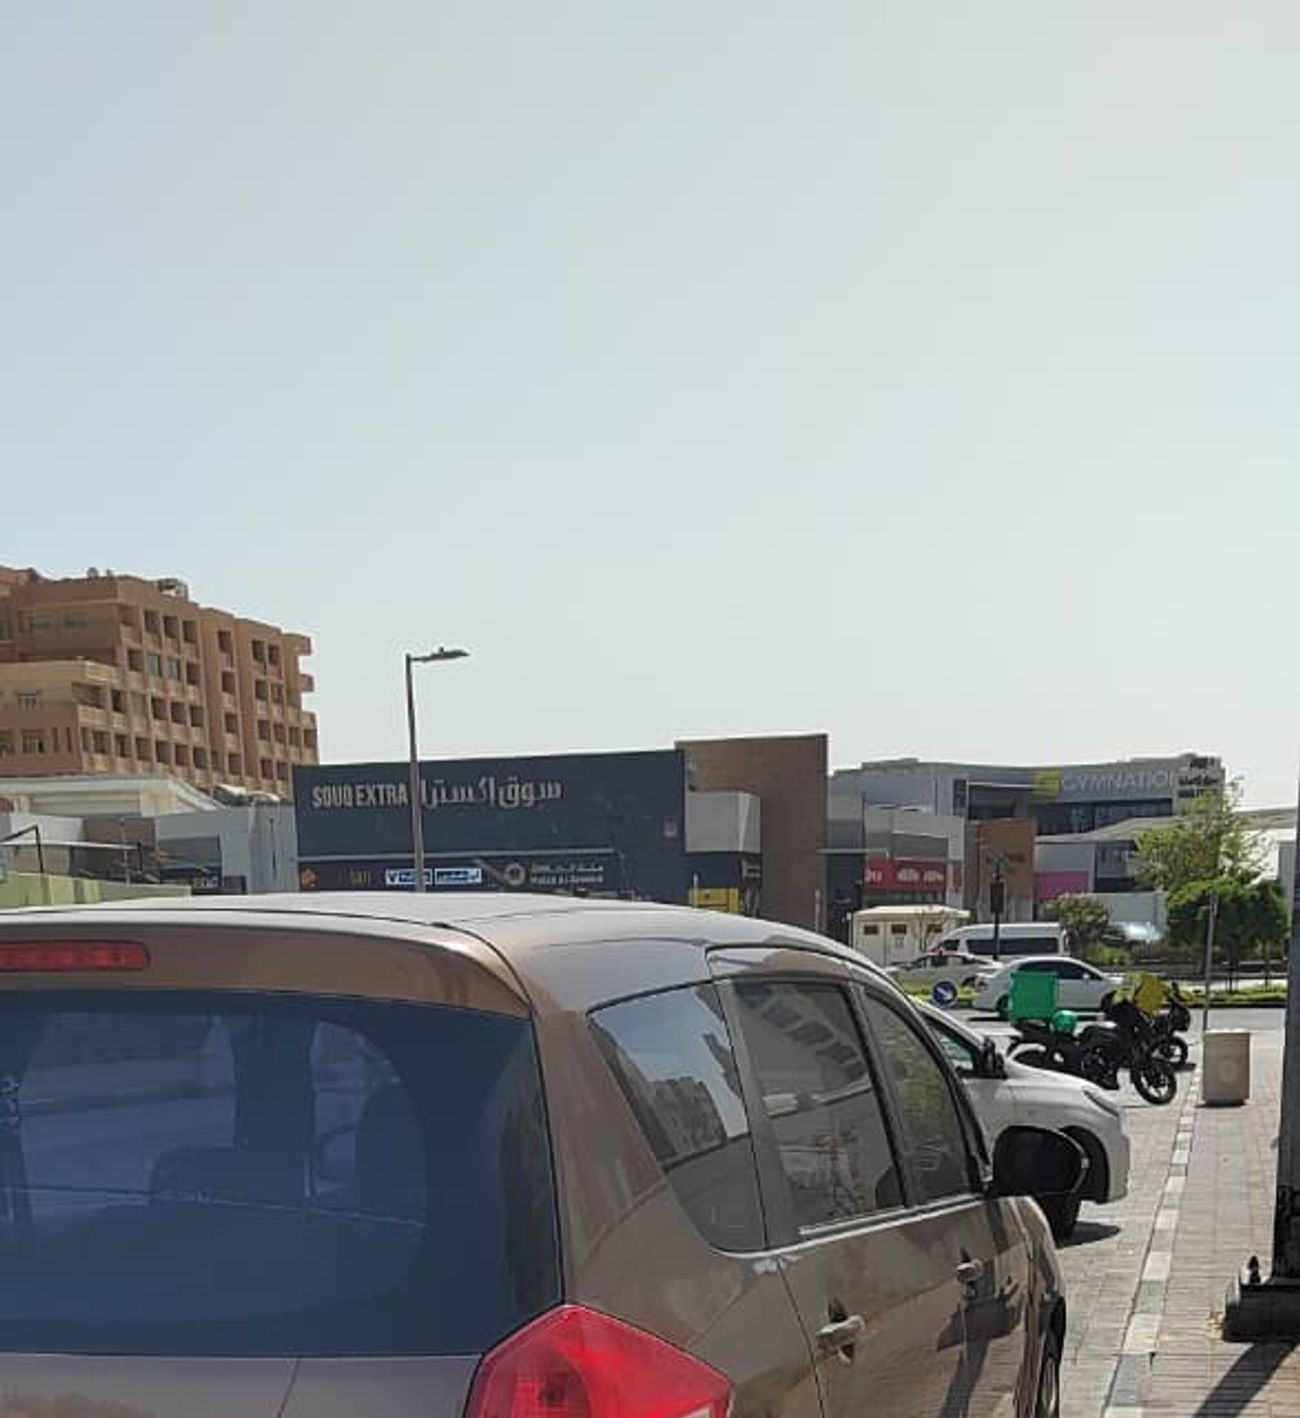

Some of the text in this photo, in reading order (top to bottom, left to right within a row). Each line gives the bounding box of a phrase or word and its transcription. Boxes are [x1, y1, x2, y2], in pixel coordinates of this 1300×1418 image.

[312, 783, 408, 808] SOUQ EXTRA
[499, 776, 562, 808] سوق
